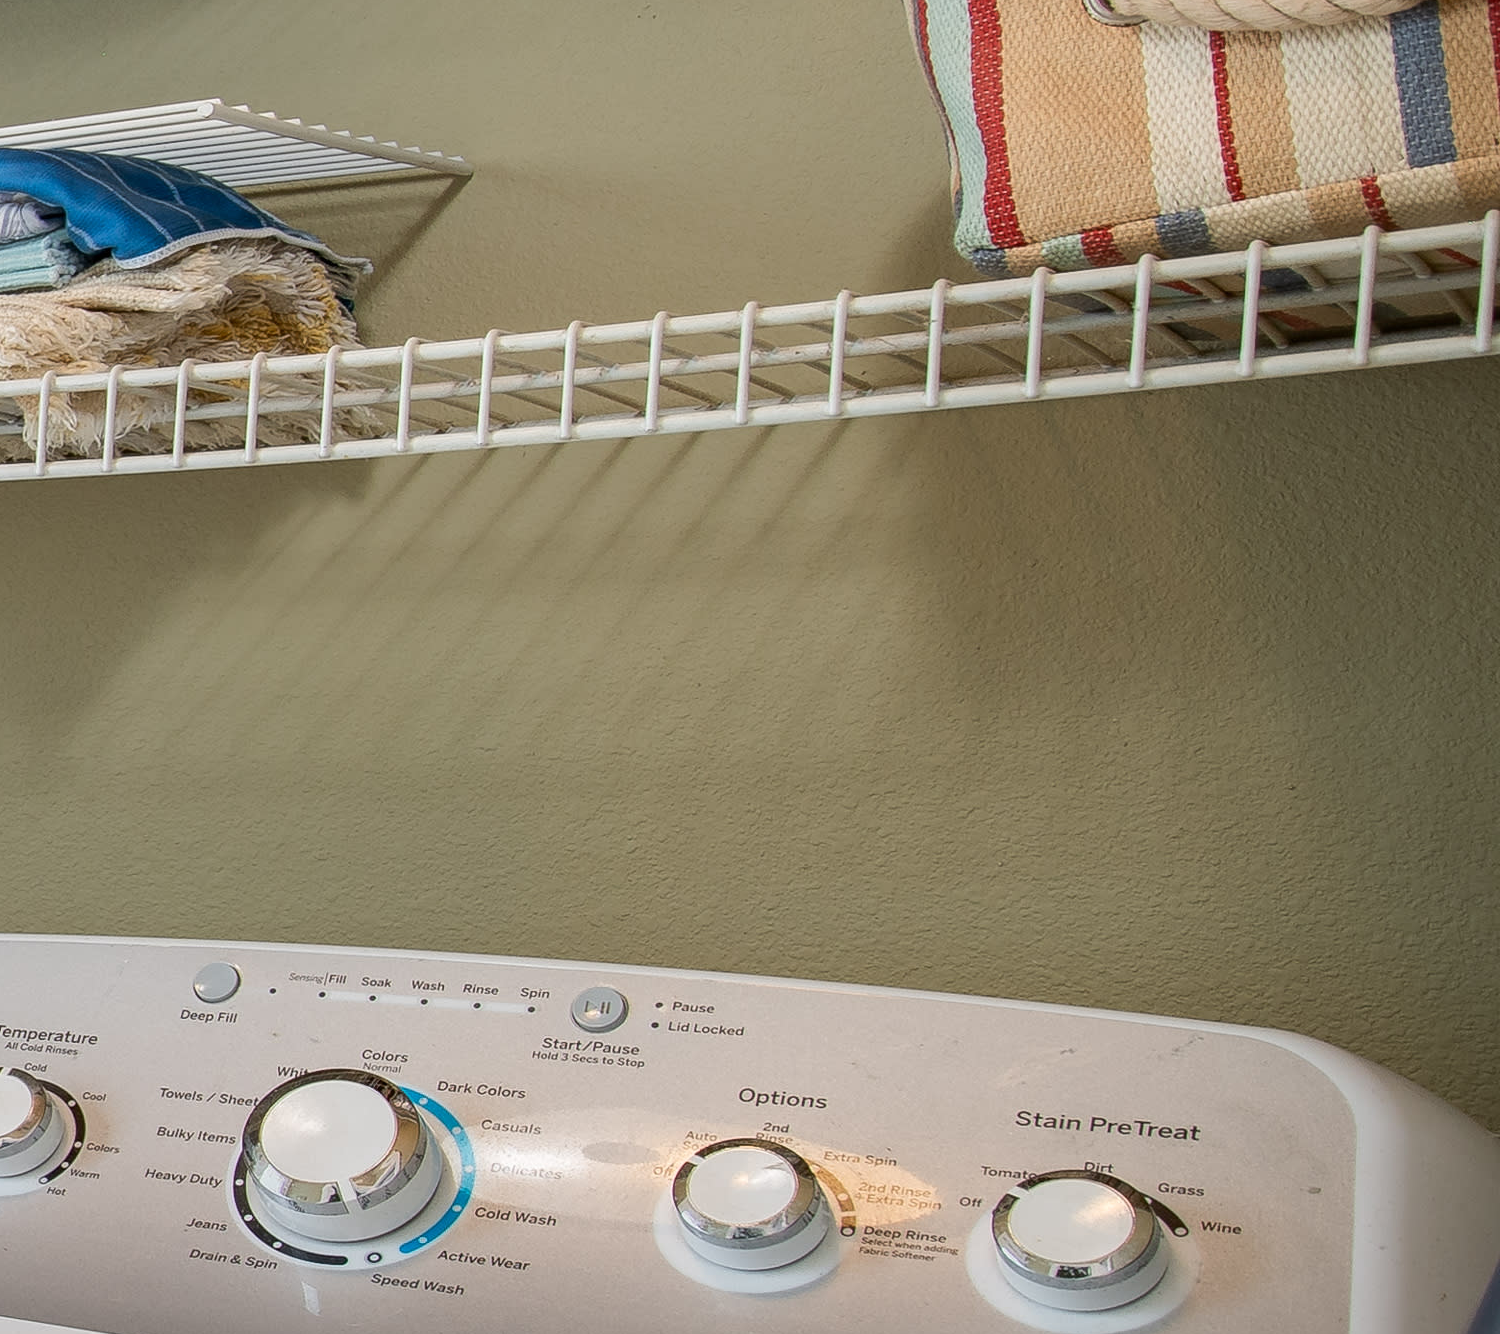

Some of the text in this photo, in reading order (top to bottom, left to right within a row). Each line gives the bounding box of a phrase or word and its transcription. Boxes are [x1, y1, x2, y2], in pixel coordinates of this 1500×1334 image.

[361, 976, 393, 989] Soak
[411, 979, 446, 992] Wash
[462, 983, 500, 996] Rinse
[520, 987, 551, 1000] Spin
[671, 1001, 716, 1014] Pause
[180, 1009, 238, 1024] Deep Fill
[667, 1021, 745, 1037] Lid Locked
[4, 1041, 80, 1057] All Cold Rinses
[541, 1036, 641, 1057] Start/Pause
[361, 1049, 410, 1063] Colors
[531, 1050, 645, 1069] Hold 3 Secs to Stop
[24, 1062, 49, 1073] Cold
[362, 1061, 403, 1074] Normal
[82, 1091, 108, 1102] Cool
[159, 1087, 203, 1102] Towels
[218, 1093, 260, 1107] Sheet
[437, 1080, 528, 1099] Dark Colors
[738, 1087, 829, 1110] Options
[481, 1119, 543, 1136] Casuals
[762, 1122, 791, 1134] 2nd
[1015, 1110, 1202, 1142] Stain PreTreat
[156, 1126, 237, 1145] Bulky Items
[685, 1130, 718, 1142] Auto
[755, 1132, 794, 1145] Rinse
[86, 1142, 122, 1155] Colors
[823, 1150, 898, 1167] Extra Spin
[69, 1168, 101, 1180] Warm
[490, 1162, 563, 1181] Delicates
[980, 1166, 1039, 1180] Tomato
[1083, 1161, 1114, 1174] Dirt
[144, 1168, 223, 1189] Heavy Duty
[46, 1186, 68, 1197] Hot
[858, 1181, 932, 1198] 2nd Rinse
[1157, 1182, 1206, 1197] Grass
[907, 1197, 942, 1211] Spin
[958, 1196, 984, 1209] Off
[474, 1206, 558, 1227] Cold Wash
[186, 1218, 228, 1233] Jeans
[1200, 1220, 1244, 1235] Wine
[863, 1226, 948, 1244] Deep Rinse
[860, 1236, 959, 1256] Select when adding
[189, 1248, 278, 1271] Drain & Spin
[437, 1250, 532, 1271] Active Wear
[858, 1247, 936, 1263] Fabric Softener
[371, 1273, 466, 1296] Speed Wash
